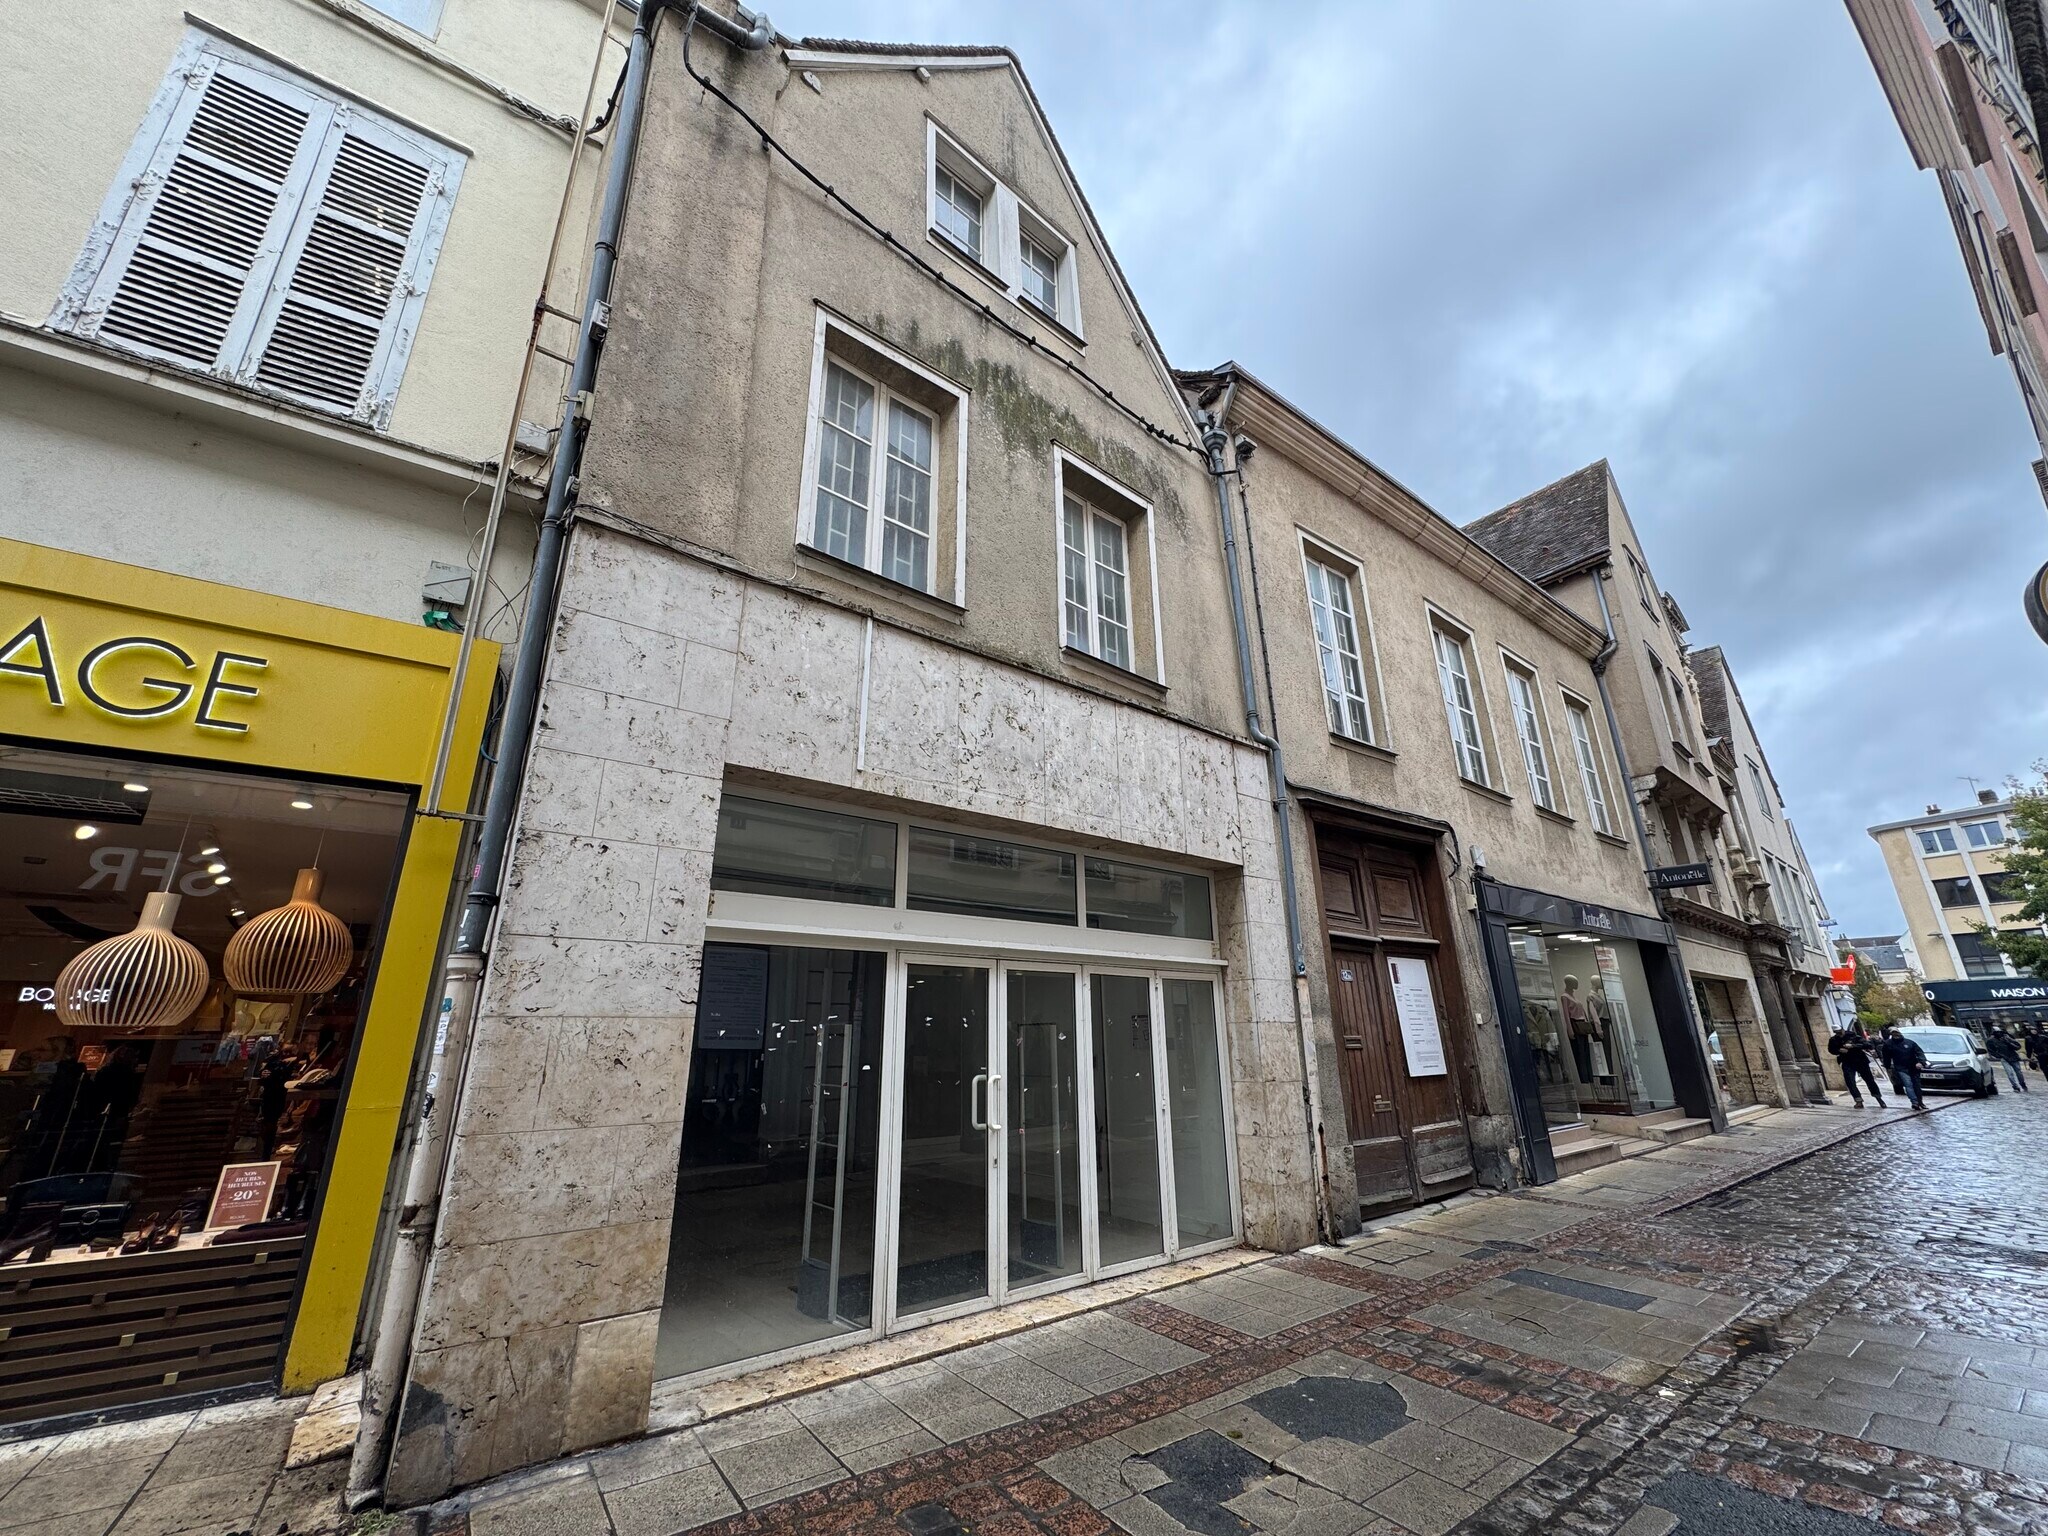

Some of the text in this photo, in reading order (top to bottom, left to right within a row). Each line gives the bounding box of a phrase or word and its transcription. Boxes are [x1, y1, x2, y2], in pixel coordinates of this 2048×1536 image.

[1660, 870, 1706, 883] Antonelle
[1582, 905, 1612, 930] Antonelle
[1990, 987, 2046, 998] MAISON
